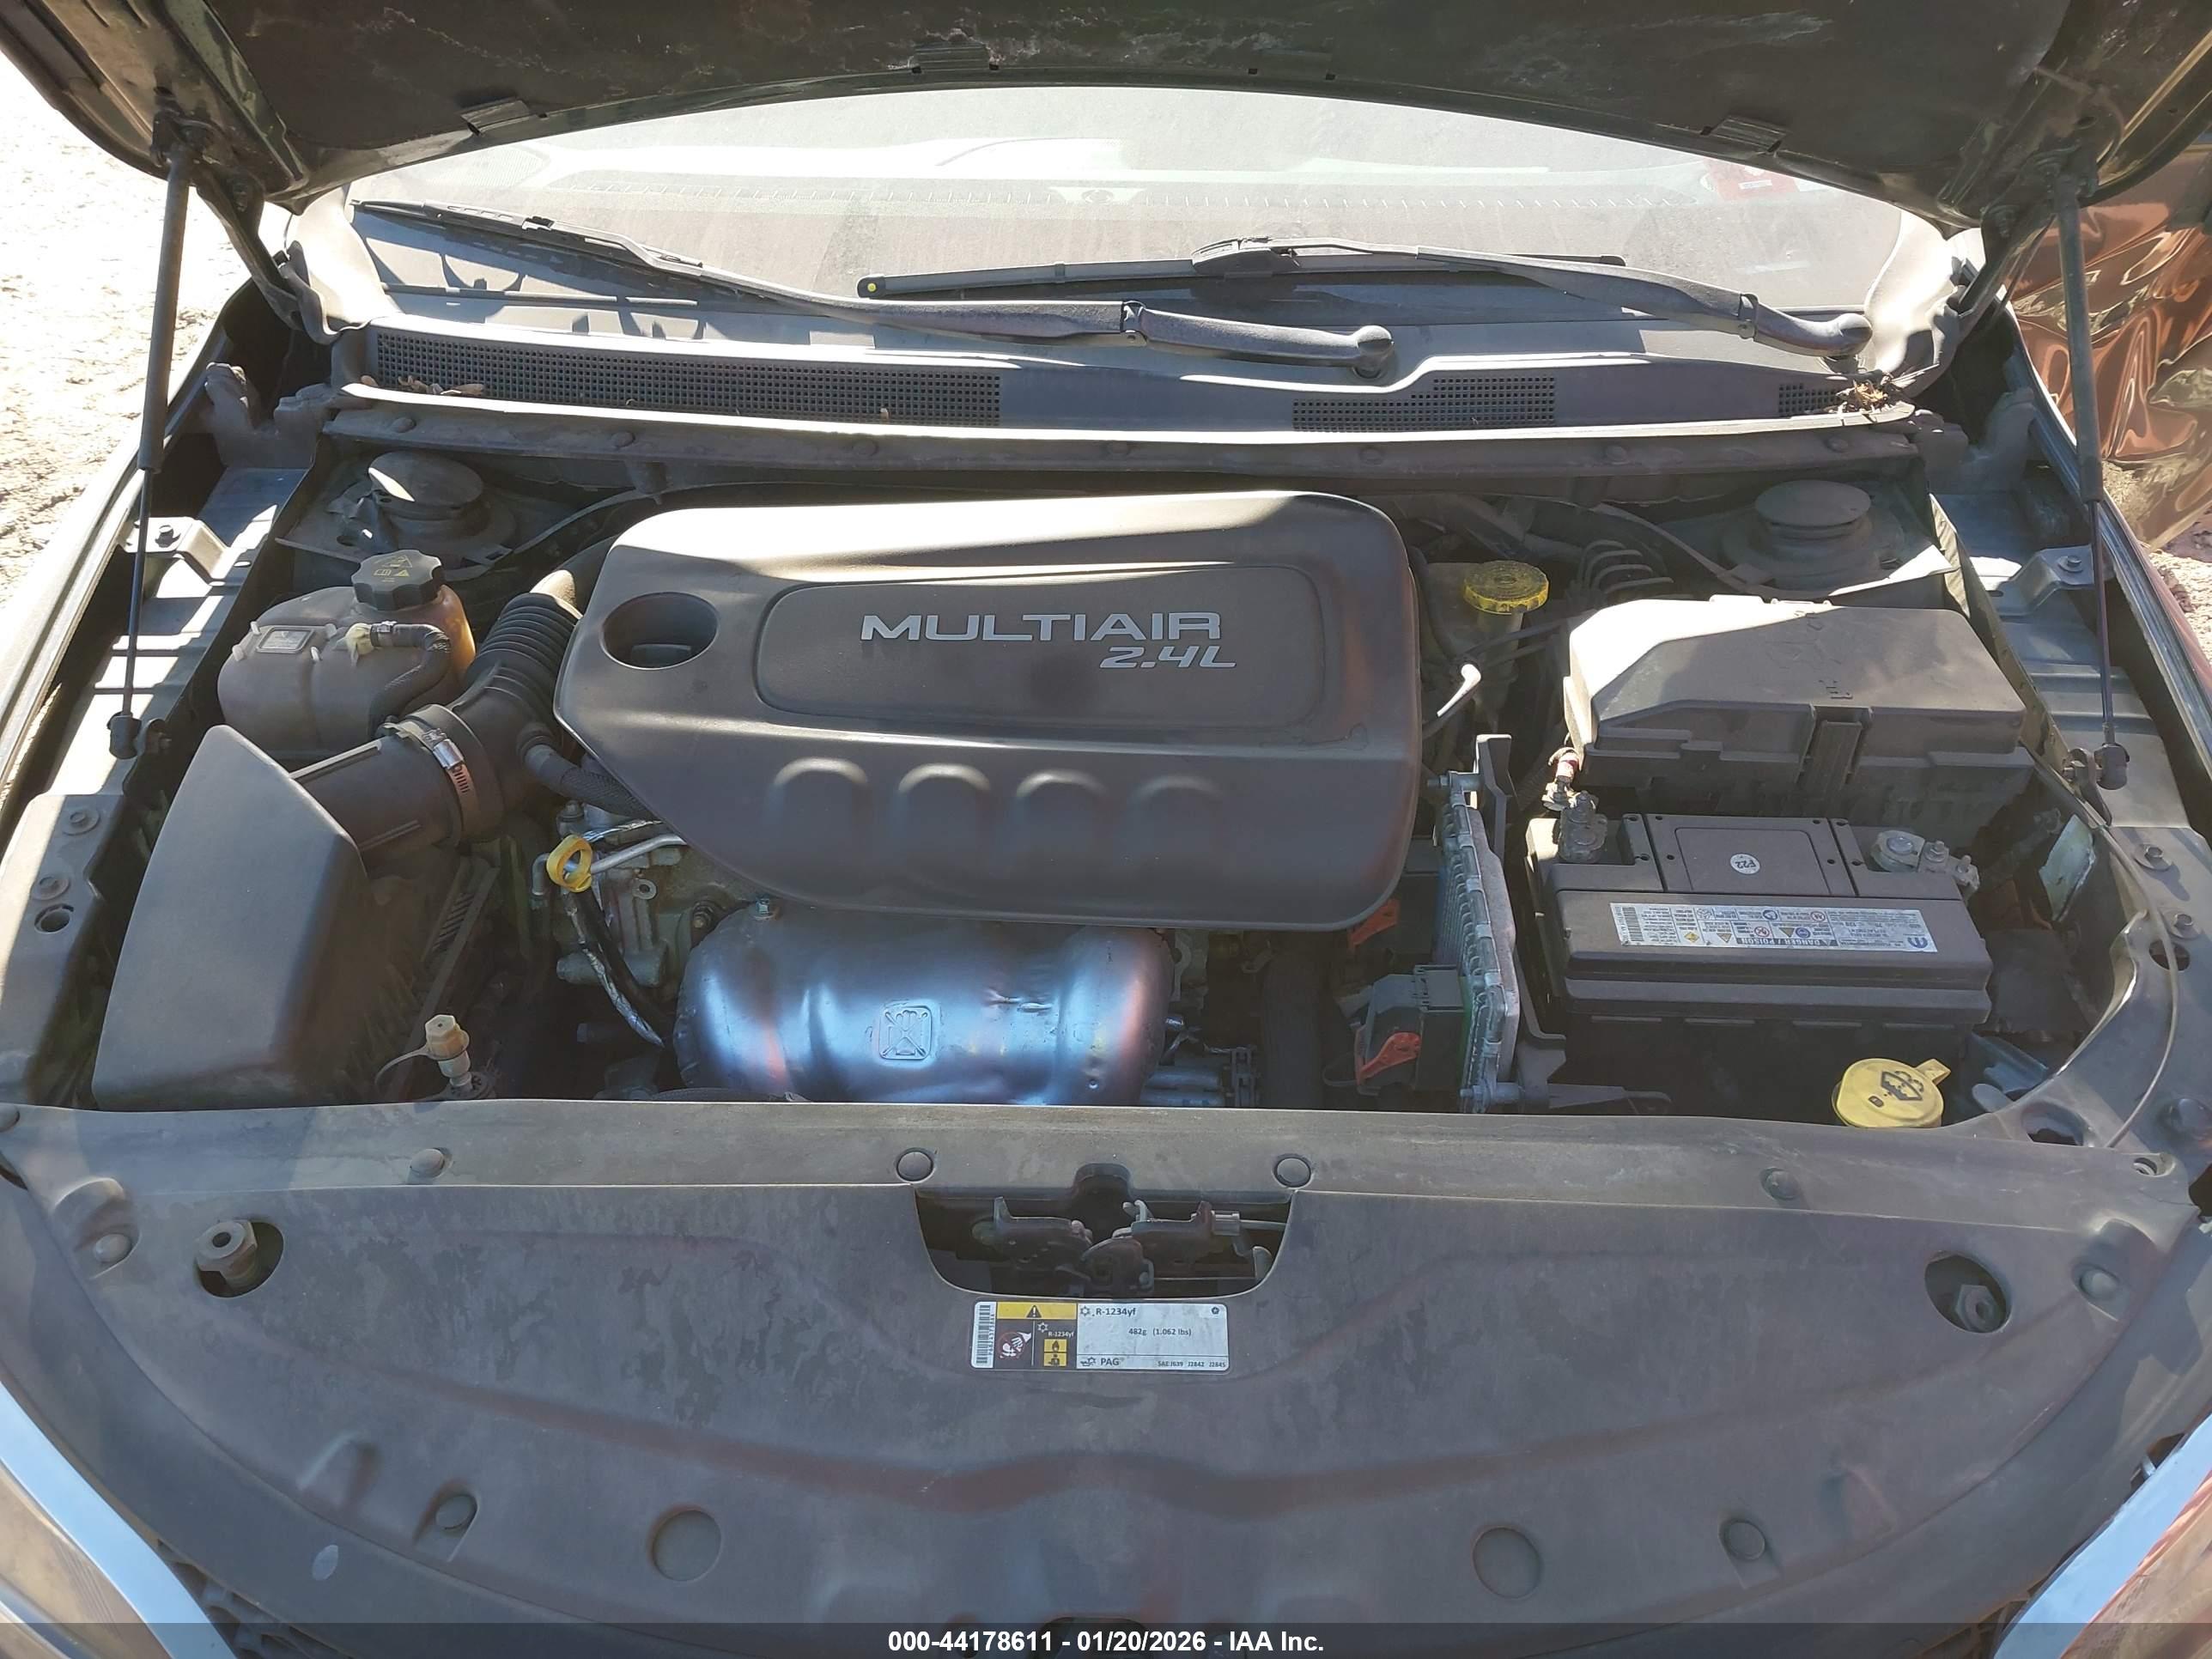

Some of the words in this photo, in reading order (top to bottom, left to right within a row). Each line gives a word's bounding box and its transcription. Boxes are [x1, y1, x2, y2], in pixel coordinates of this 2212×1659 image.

[860, 611, 1221, 641] MULTIAIR
[1099, 646, 1237, 669] 2.4L
[1096, 1307, 1136, 1317] R-1234yf
[1128, 1328, 1147, 1336] 482g
[1152, 1328, 1176, 1336] (1.062
[1177, 1328, 1192, 1336] lbs)
[1100, 1357, 1120, 1366] PAG
